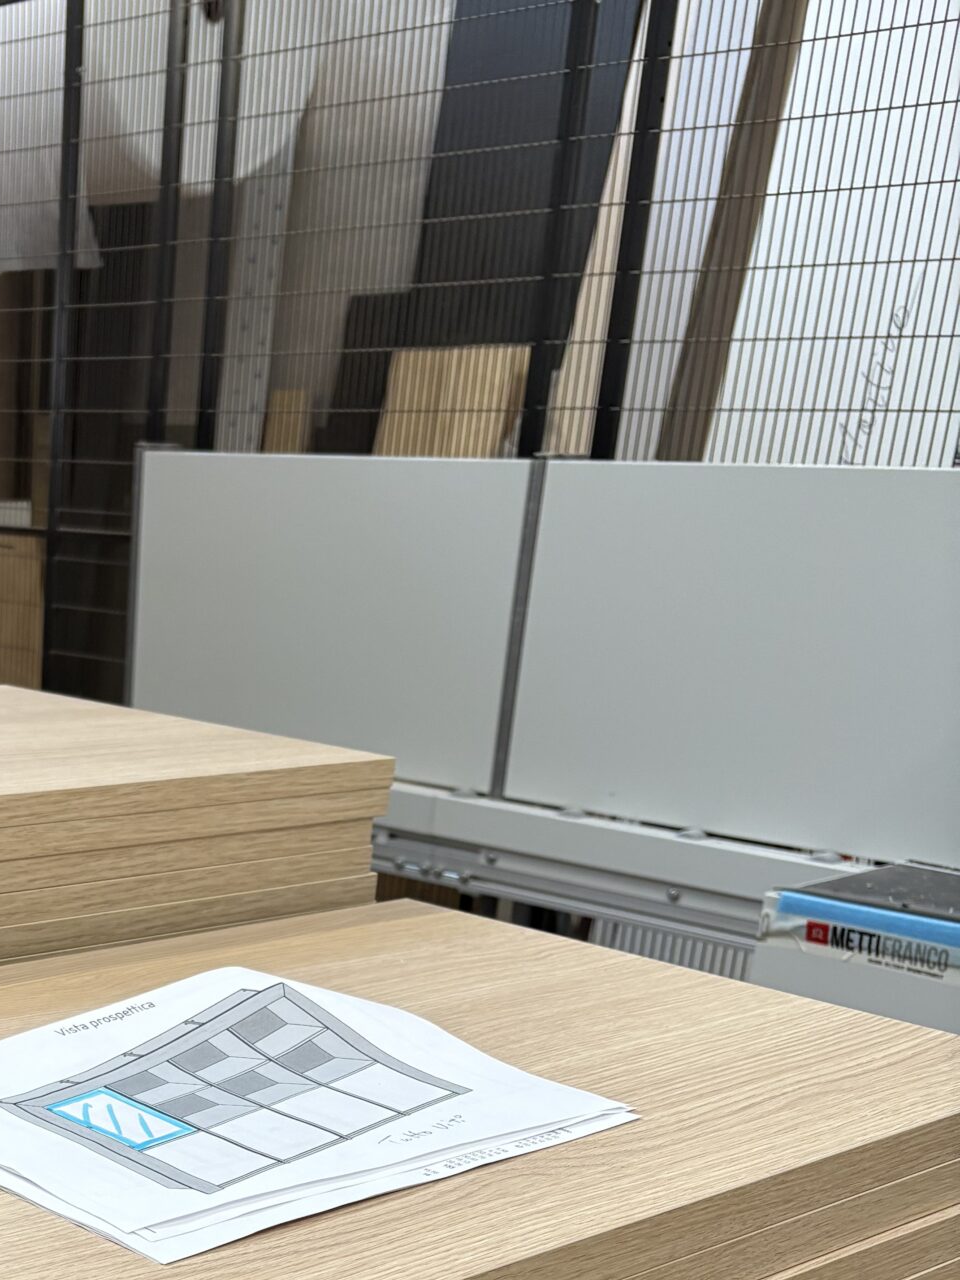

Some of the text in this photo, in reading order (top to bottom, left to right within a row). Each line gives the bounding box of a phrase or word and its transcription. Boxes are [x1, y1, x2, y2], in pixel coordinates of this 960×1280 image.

[830, 925, 950, 973] METTIFRANCO
[54, 1001, 156, 1037] Vista prospettica
